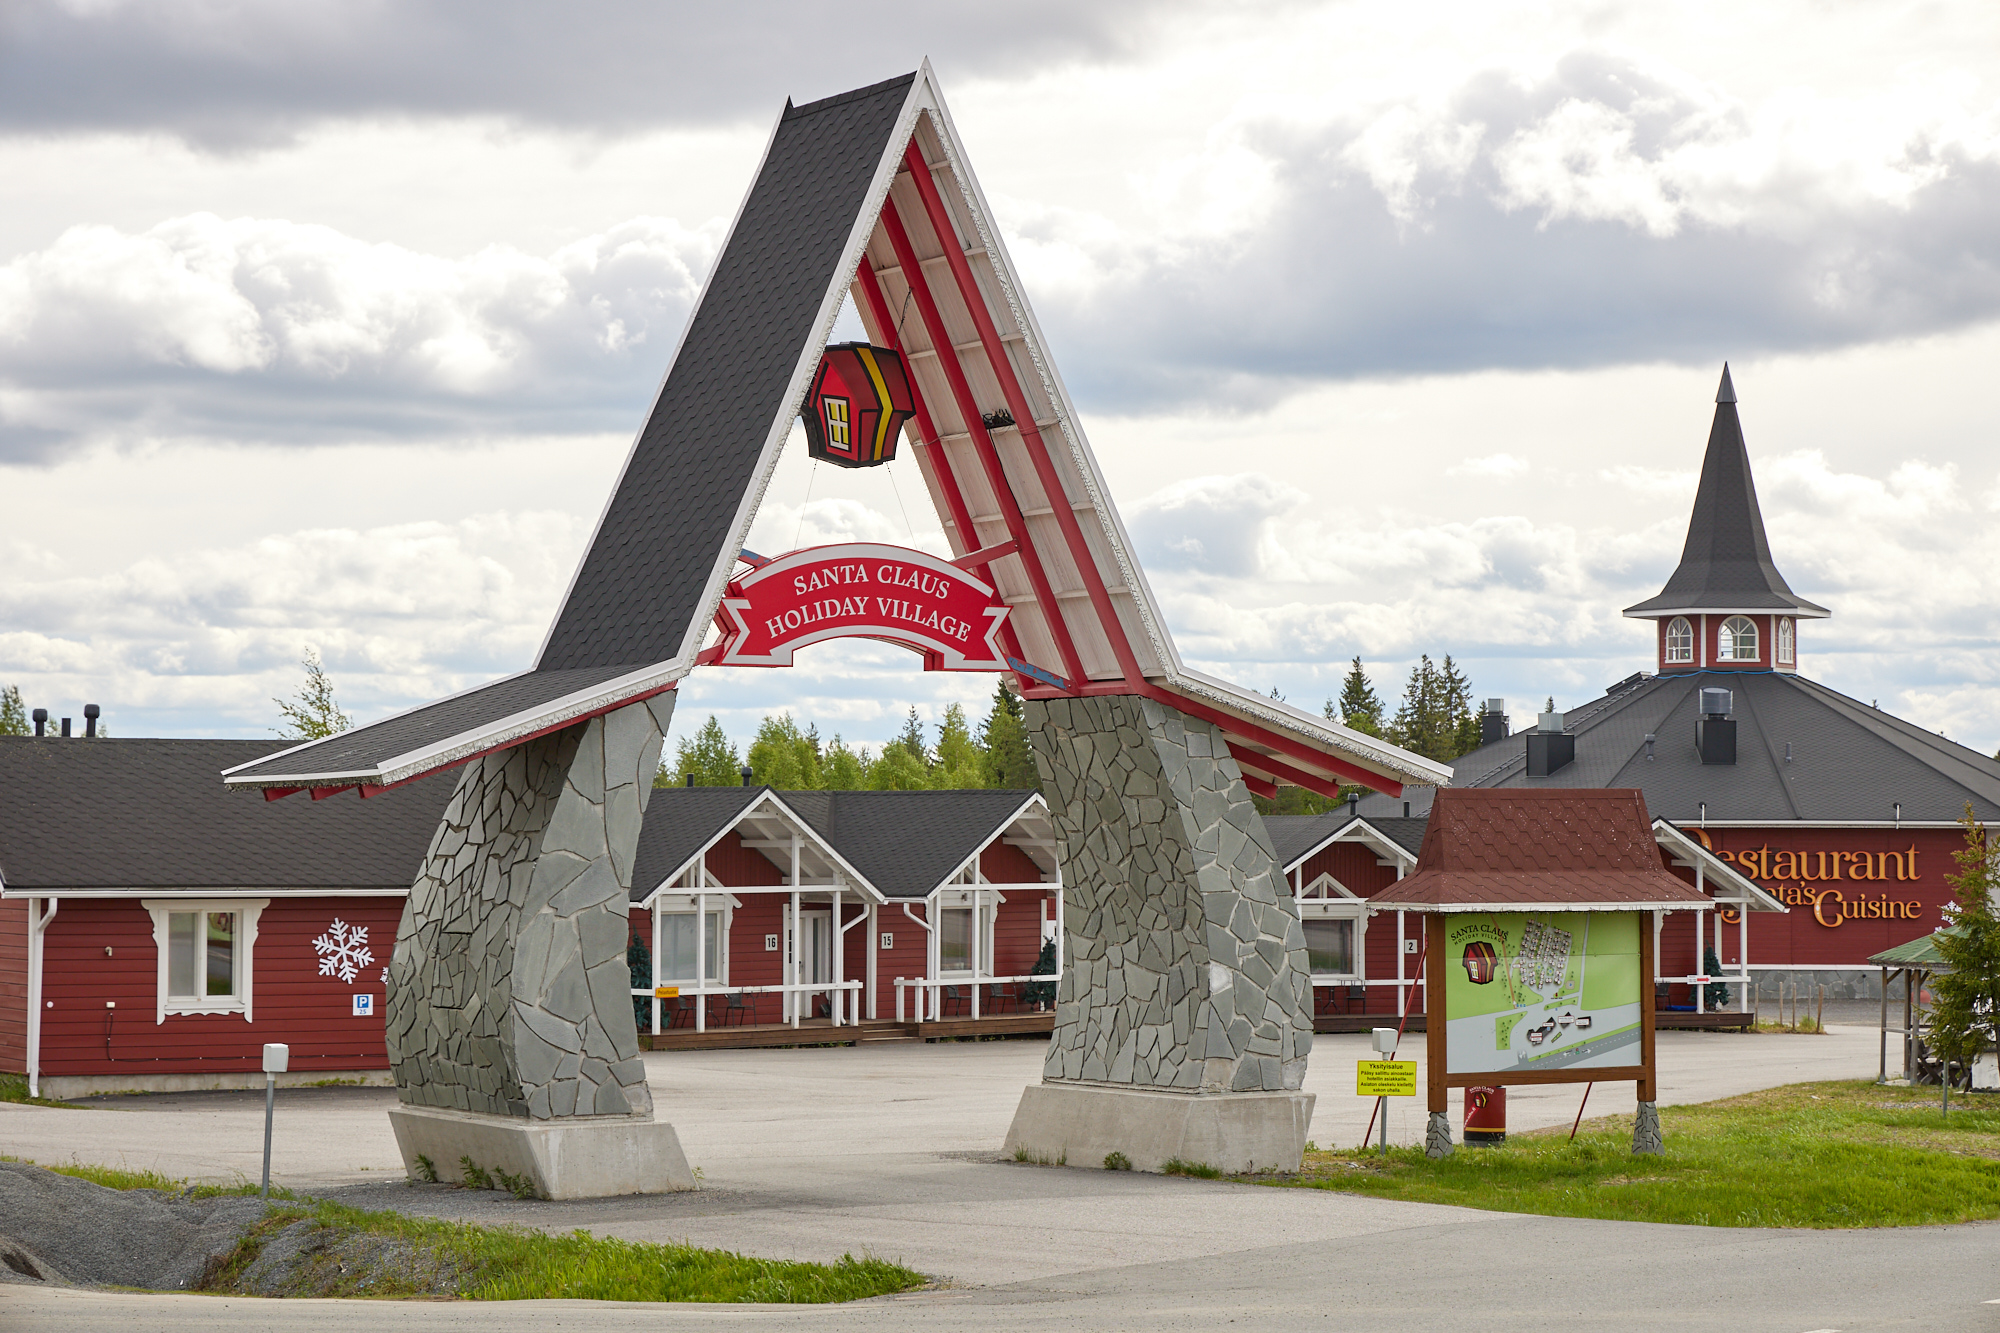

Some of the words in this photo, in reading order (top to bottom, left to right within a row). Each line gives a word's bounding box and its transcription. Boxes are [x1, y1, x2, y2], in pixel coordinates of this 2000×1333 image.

[793, 563, 869, 596] SANTA
[877, 565, 950, 599] CLAUS
[765, 596, 869, 639] HOLIDAY
[876, 597, 971, 642] VILLAGE
[1681, 828, 1921, 881] staurant
[1814, 889, 1923, 928] Cuisine
[1451, 925, 1479, 941] SANTA
[1480, 925, 1509, 941] CLAUS
[1454, 933, 1479, 946] HOLIDAY
[767, 937, 776, 948] 16
[883, 936, 892, 946] 15
[1408, 941, 1414, 951] 2
[359, 996, 368, 1008] P
[1369, 1063, 1404, 1071] Yksityisalue
